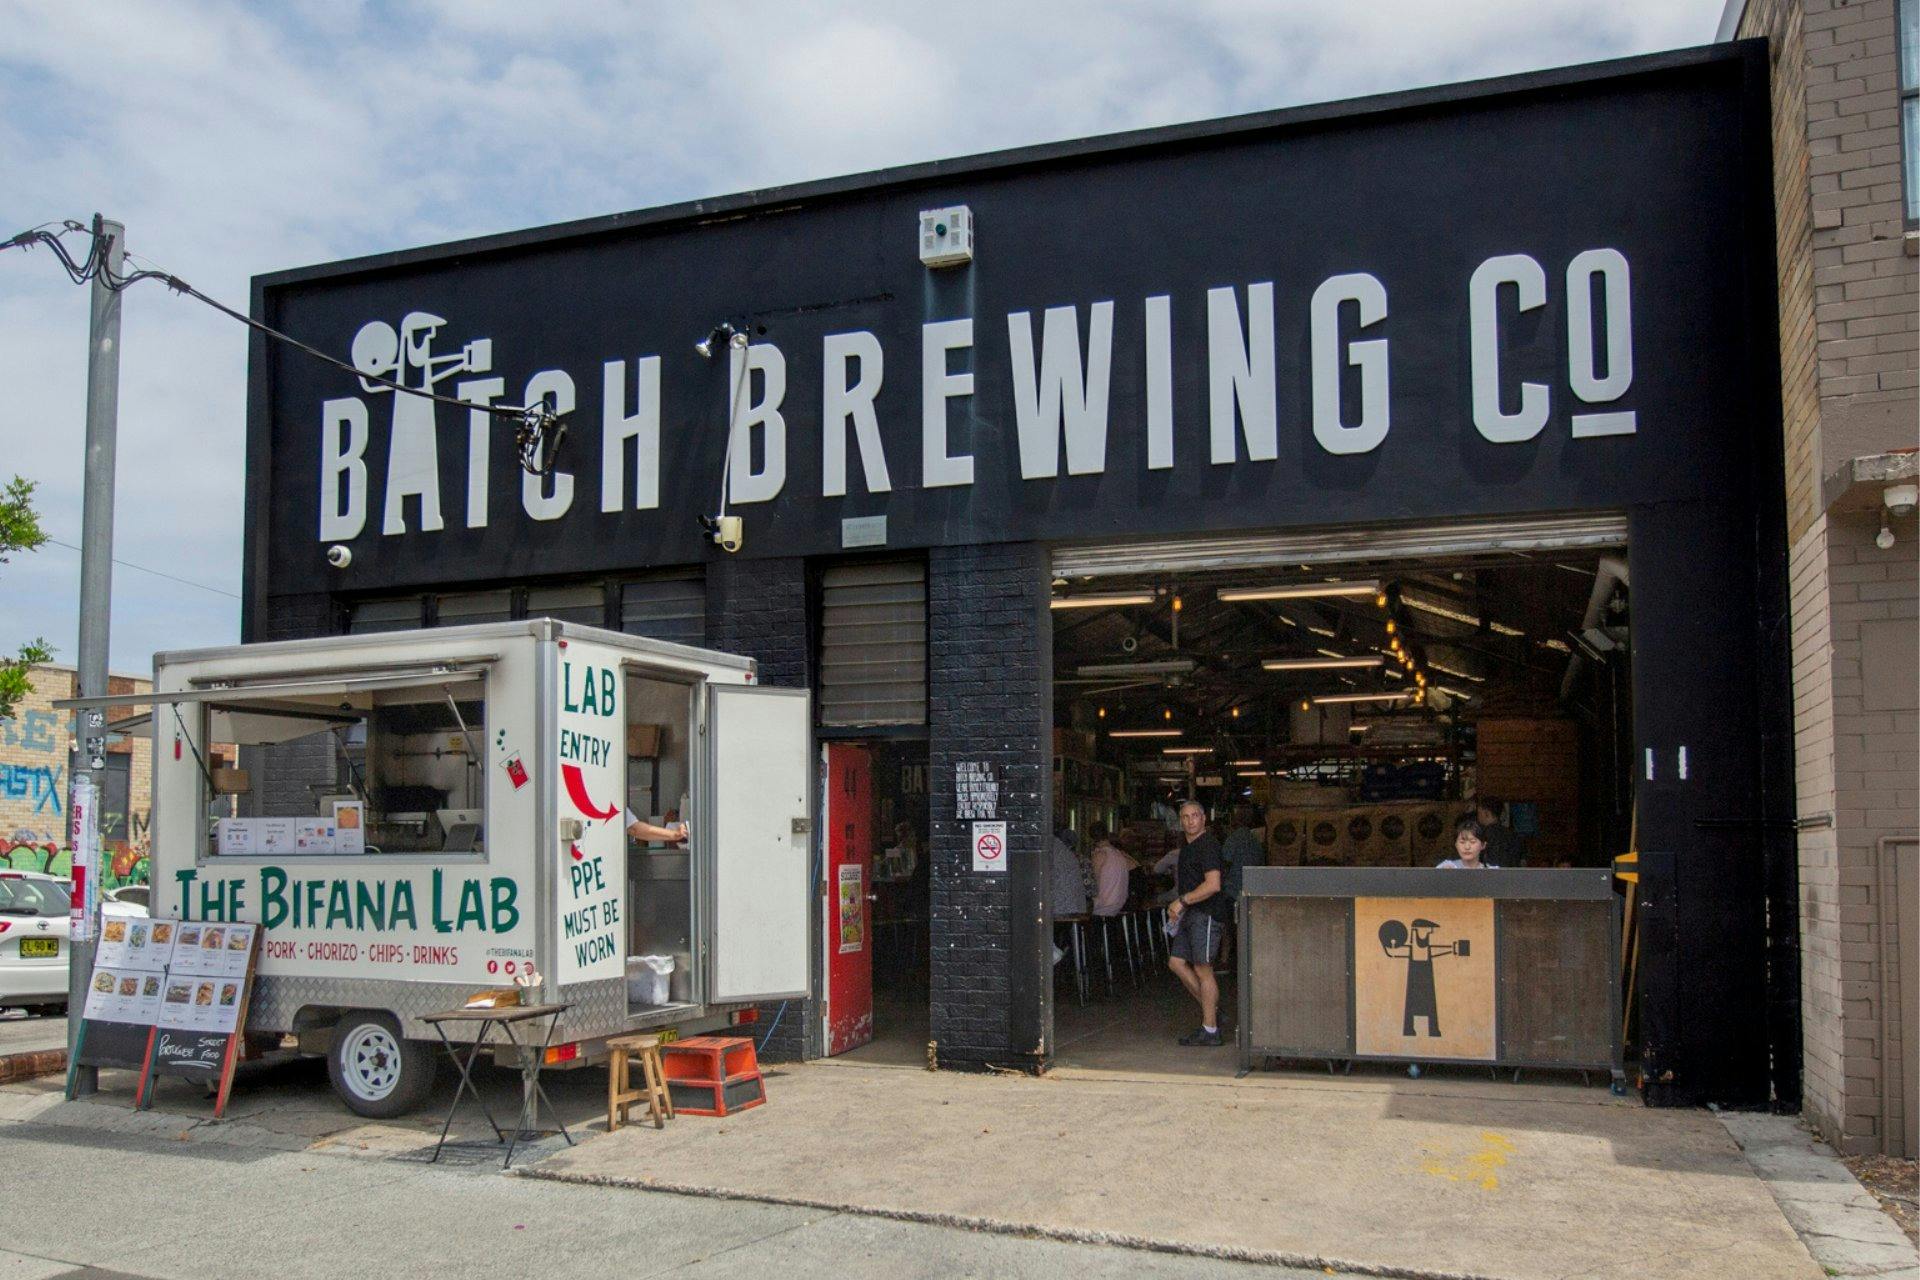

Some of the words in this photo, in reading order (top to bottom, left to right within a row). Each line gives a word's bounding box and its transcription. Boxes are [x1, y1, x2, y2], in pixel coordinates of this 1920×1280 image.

[319, 312, 662, 541] BATCH
[728, 272, 1390, 505] BREWING
[562, 662, 617, 717] LAB
[559, 729, 612, 768] ENTRY
[570, 856, 606, 899] PPE
[175, 868, 246, 923] THE
[260, 865, 418, 932] BIFANA
[432, 866, 521, 934] LAB
[563, 902, 598, 940] MUST
[602, 898, 620, 926] BE
[266, 941, 297, 960] PORK
[307, 941, 358, 962] CHORIZO
[369, 943, 405, 963] CHIPS
[413, 945, 459, 966] DRINKS
[574, 932, 617, 969] WORN
